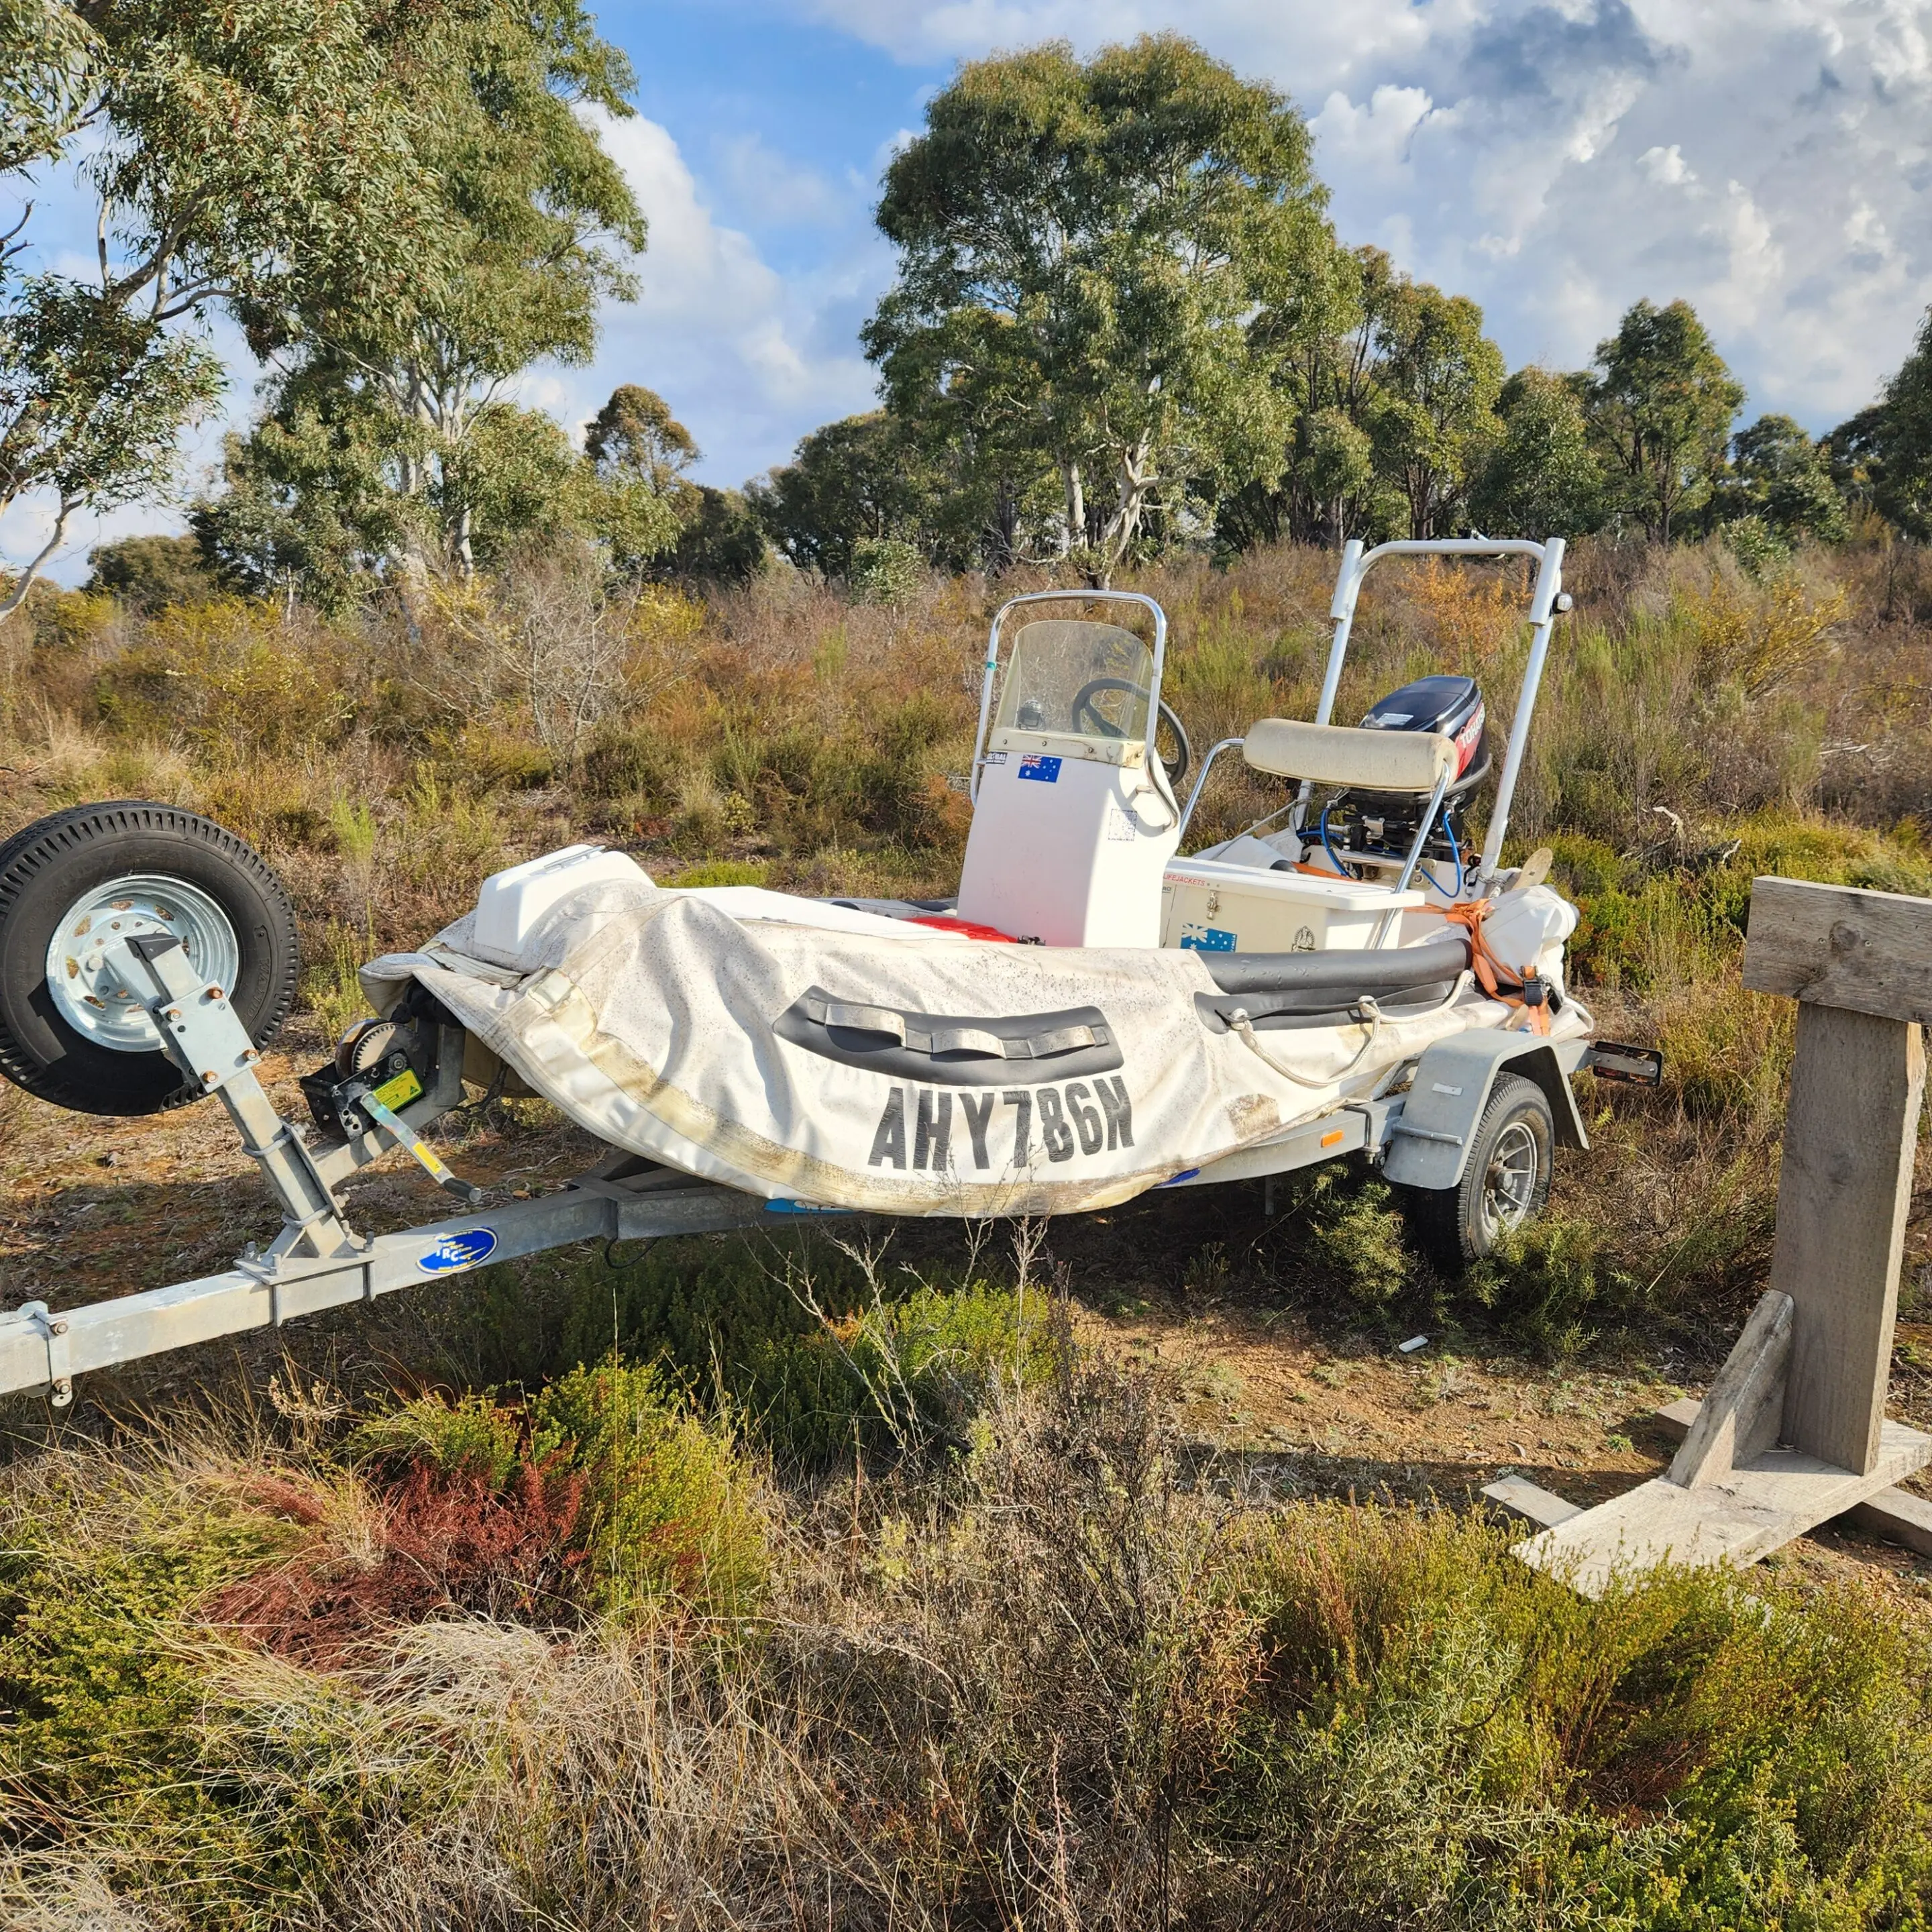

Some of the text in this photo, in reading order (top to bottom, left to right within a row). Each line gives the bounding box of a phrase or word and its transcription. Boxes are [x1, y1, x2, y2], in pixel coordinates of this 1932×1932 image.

[1460, 702, 1485, 749] TOHATS
[1163, 873, 1205, 886] LIFEJACKETS
[867, 1075, 1134, 1171] AHY786N
